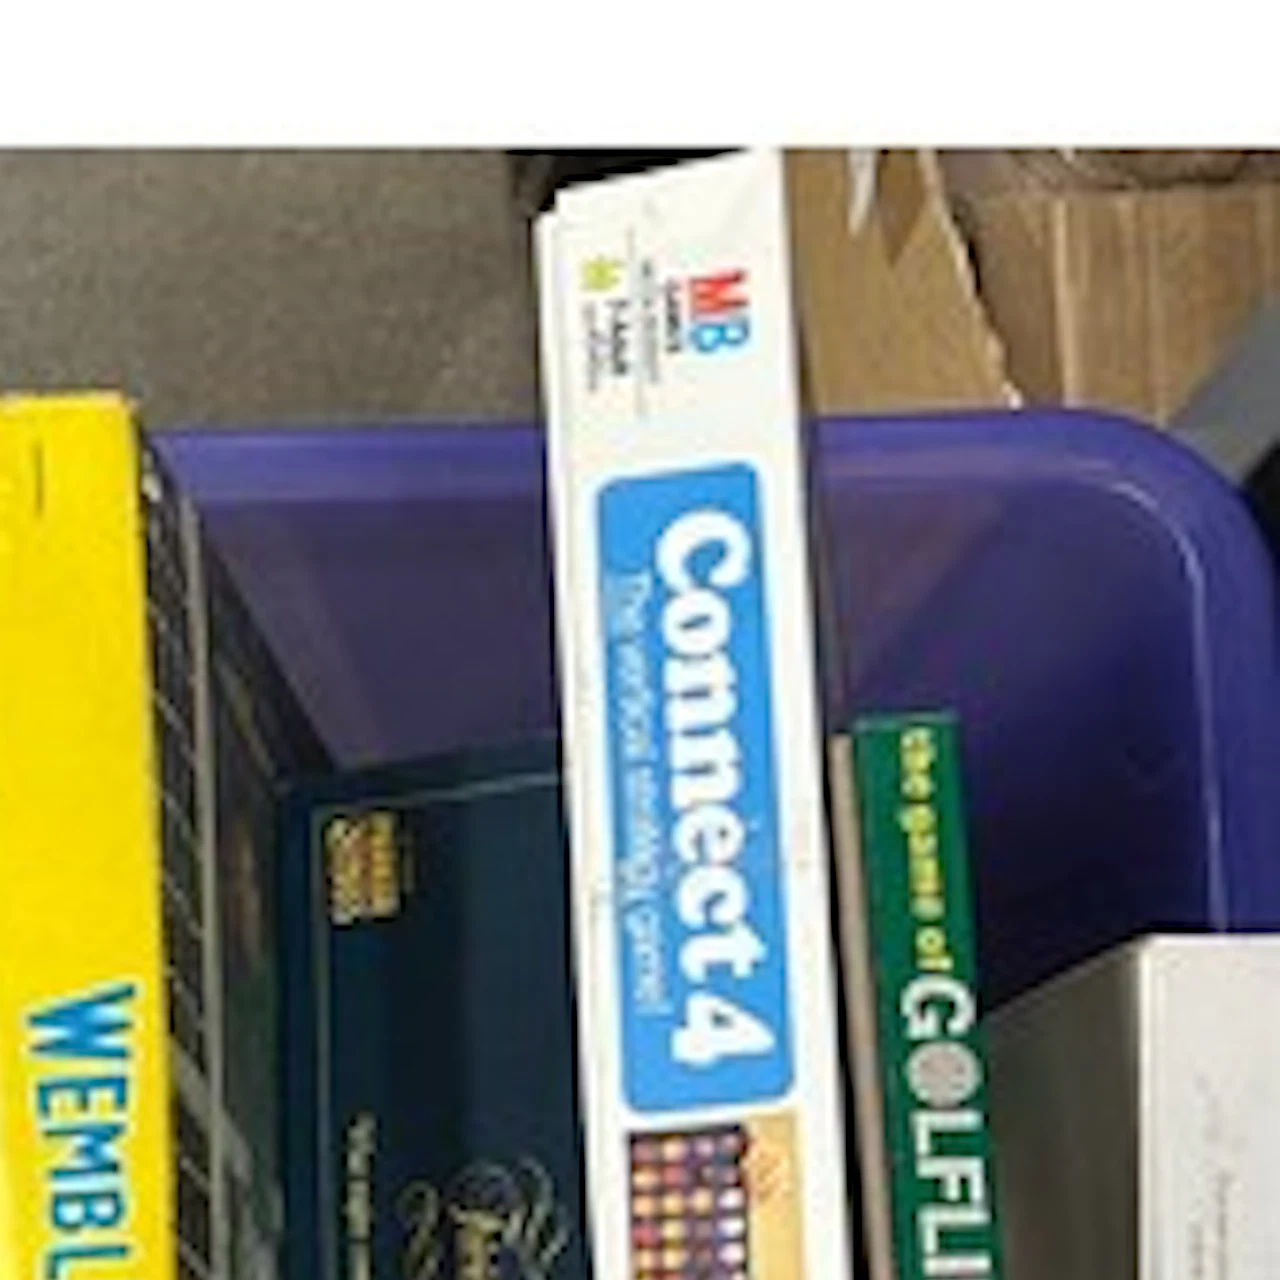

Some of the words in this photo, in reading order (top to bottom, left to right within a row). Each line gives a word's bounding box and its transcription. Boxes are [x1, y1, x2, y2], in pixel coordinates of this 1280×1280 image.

[688, 269, 749, 354] MB
[654, 508, 765, 984] Connect
[901, 727, 938, 798] the
[898, 804, 944, 918] game
[913, 926, 954, 973] of
[670, 994, 775, 1066] 4
